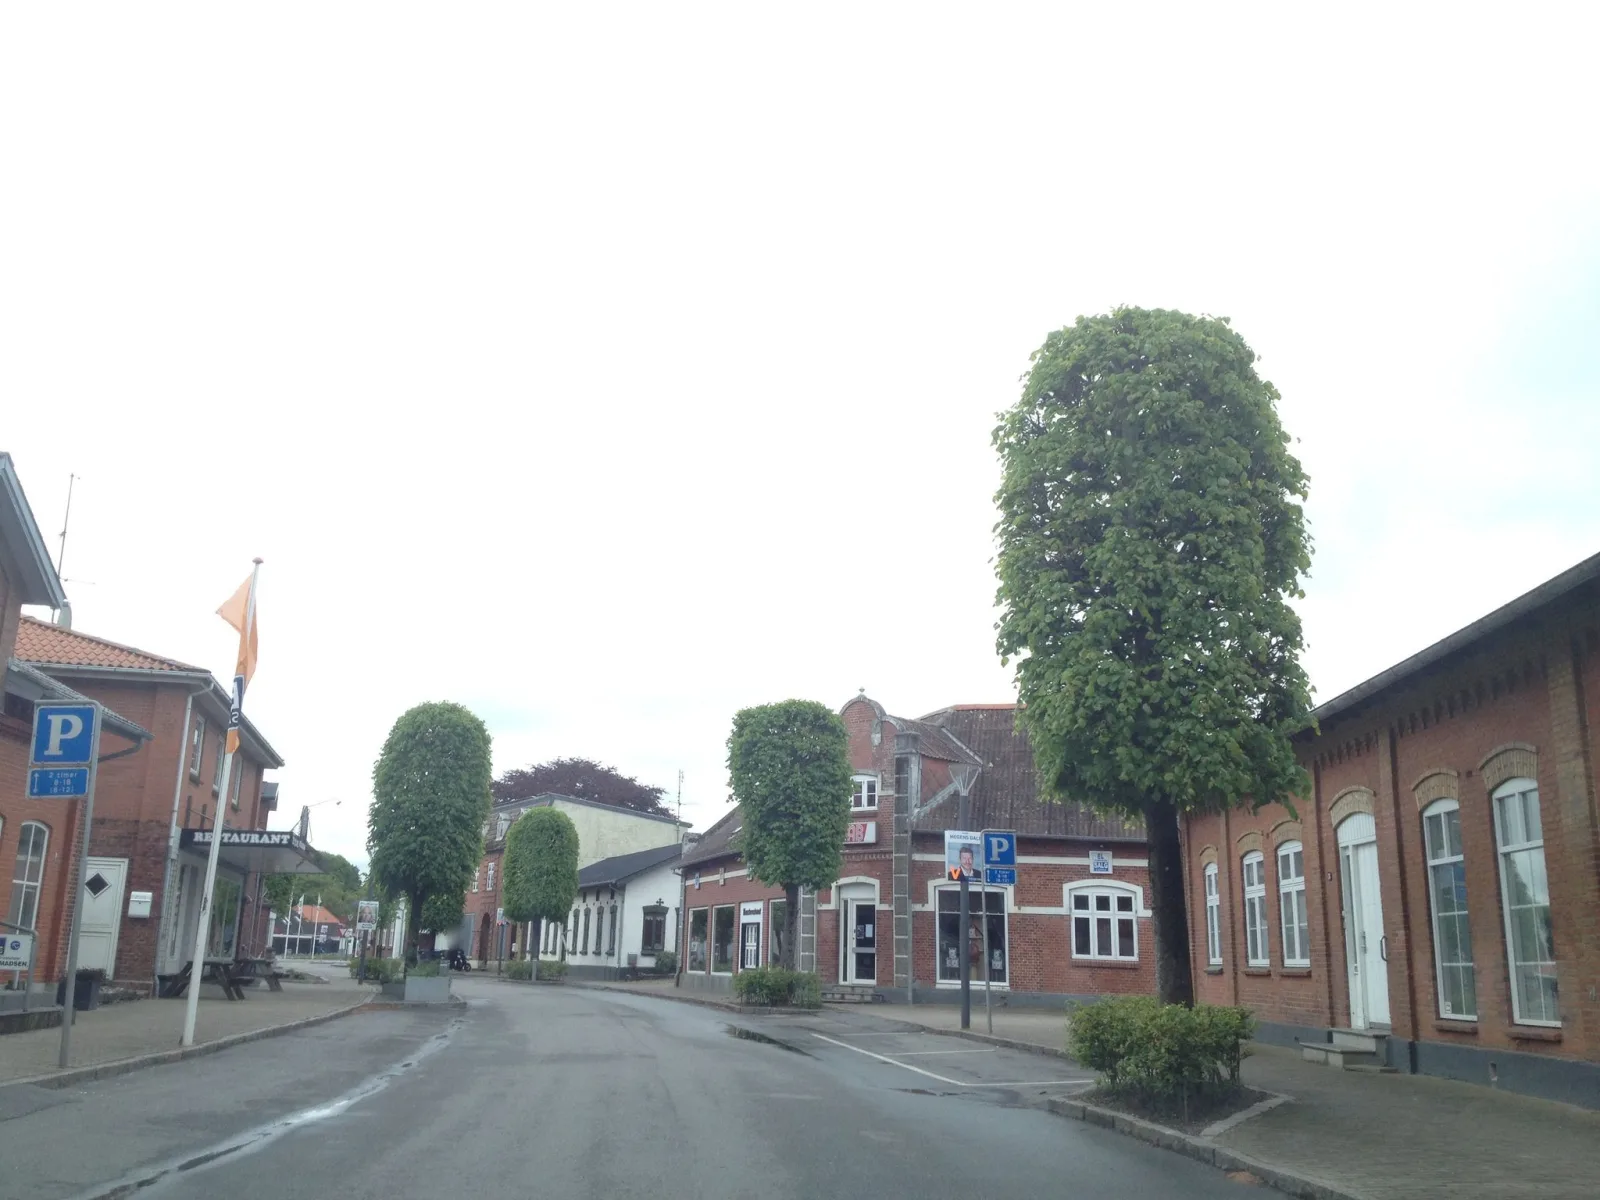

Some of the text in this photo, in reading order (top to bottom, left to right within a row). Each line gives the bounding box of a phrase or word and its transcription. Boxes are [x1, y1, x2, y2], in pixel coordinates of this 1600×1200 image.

[44, 714, 83, 755] P
[193, 831, 291, 845] RETAURANT
[989, 837, 1009, 861] P
